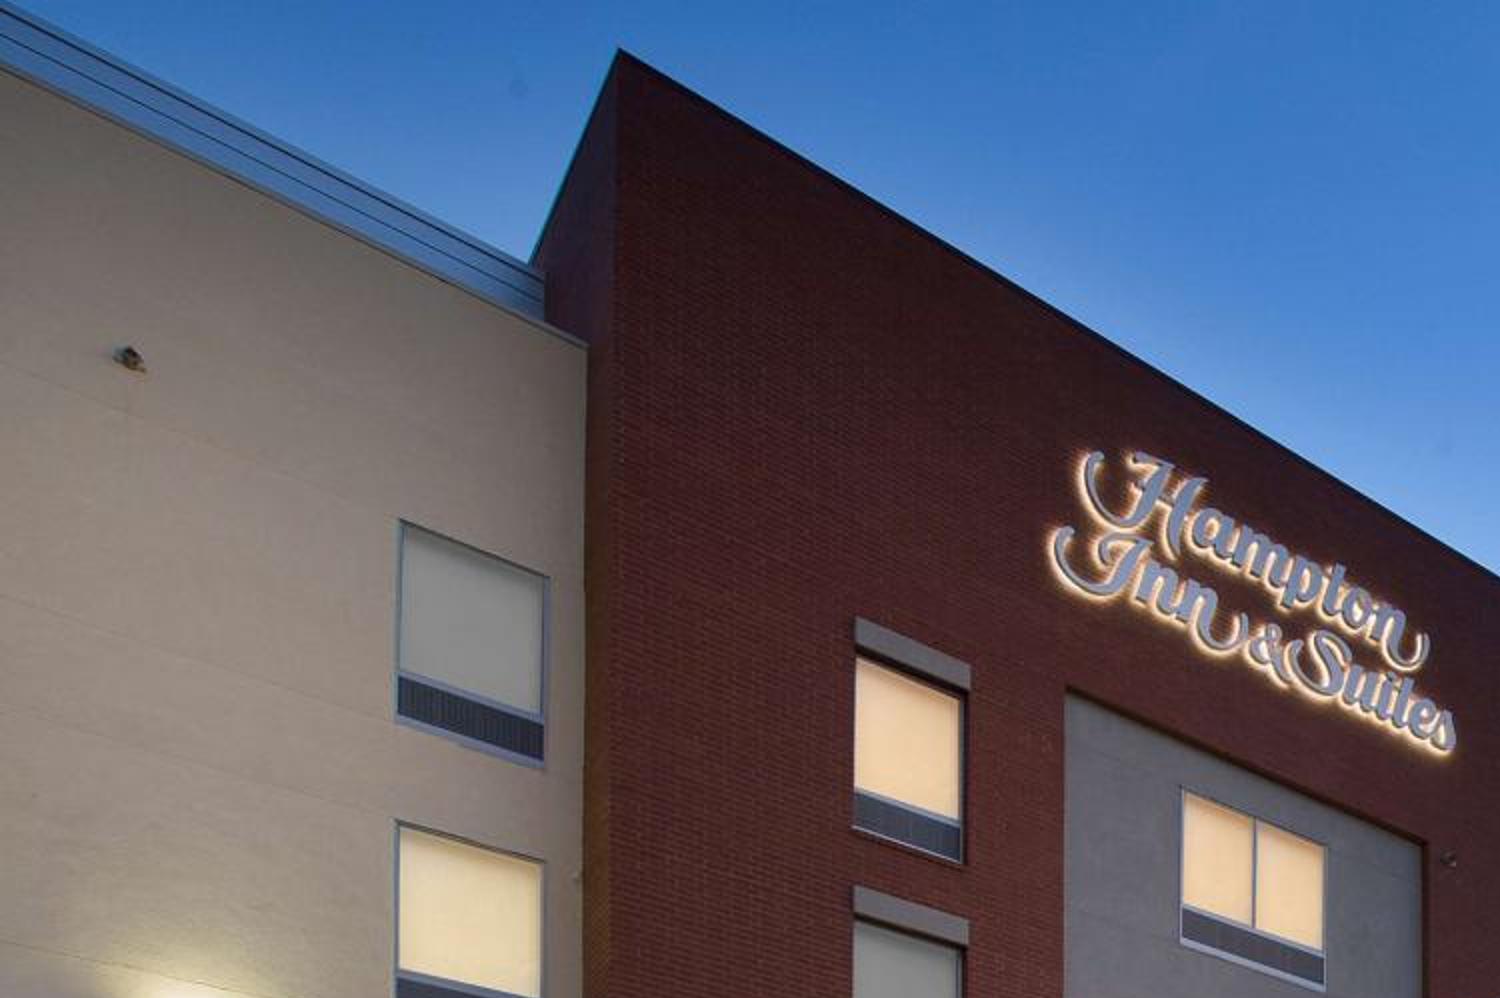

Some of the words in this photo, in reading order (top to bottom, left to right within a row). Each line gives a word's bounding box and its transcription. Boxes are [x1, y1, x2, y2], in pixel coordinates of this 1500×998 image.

[1053, 524, 1249, 652] Inn
[1248, 623, 1292, 684] &
[1288, 629, 1457, 752] Suites
[1082, 449, 1431, 670] Hampton
